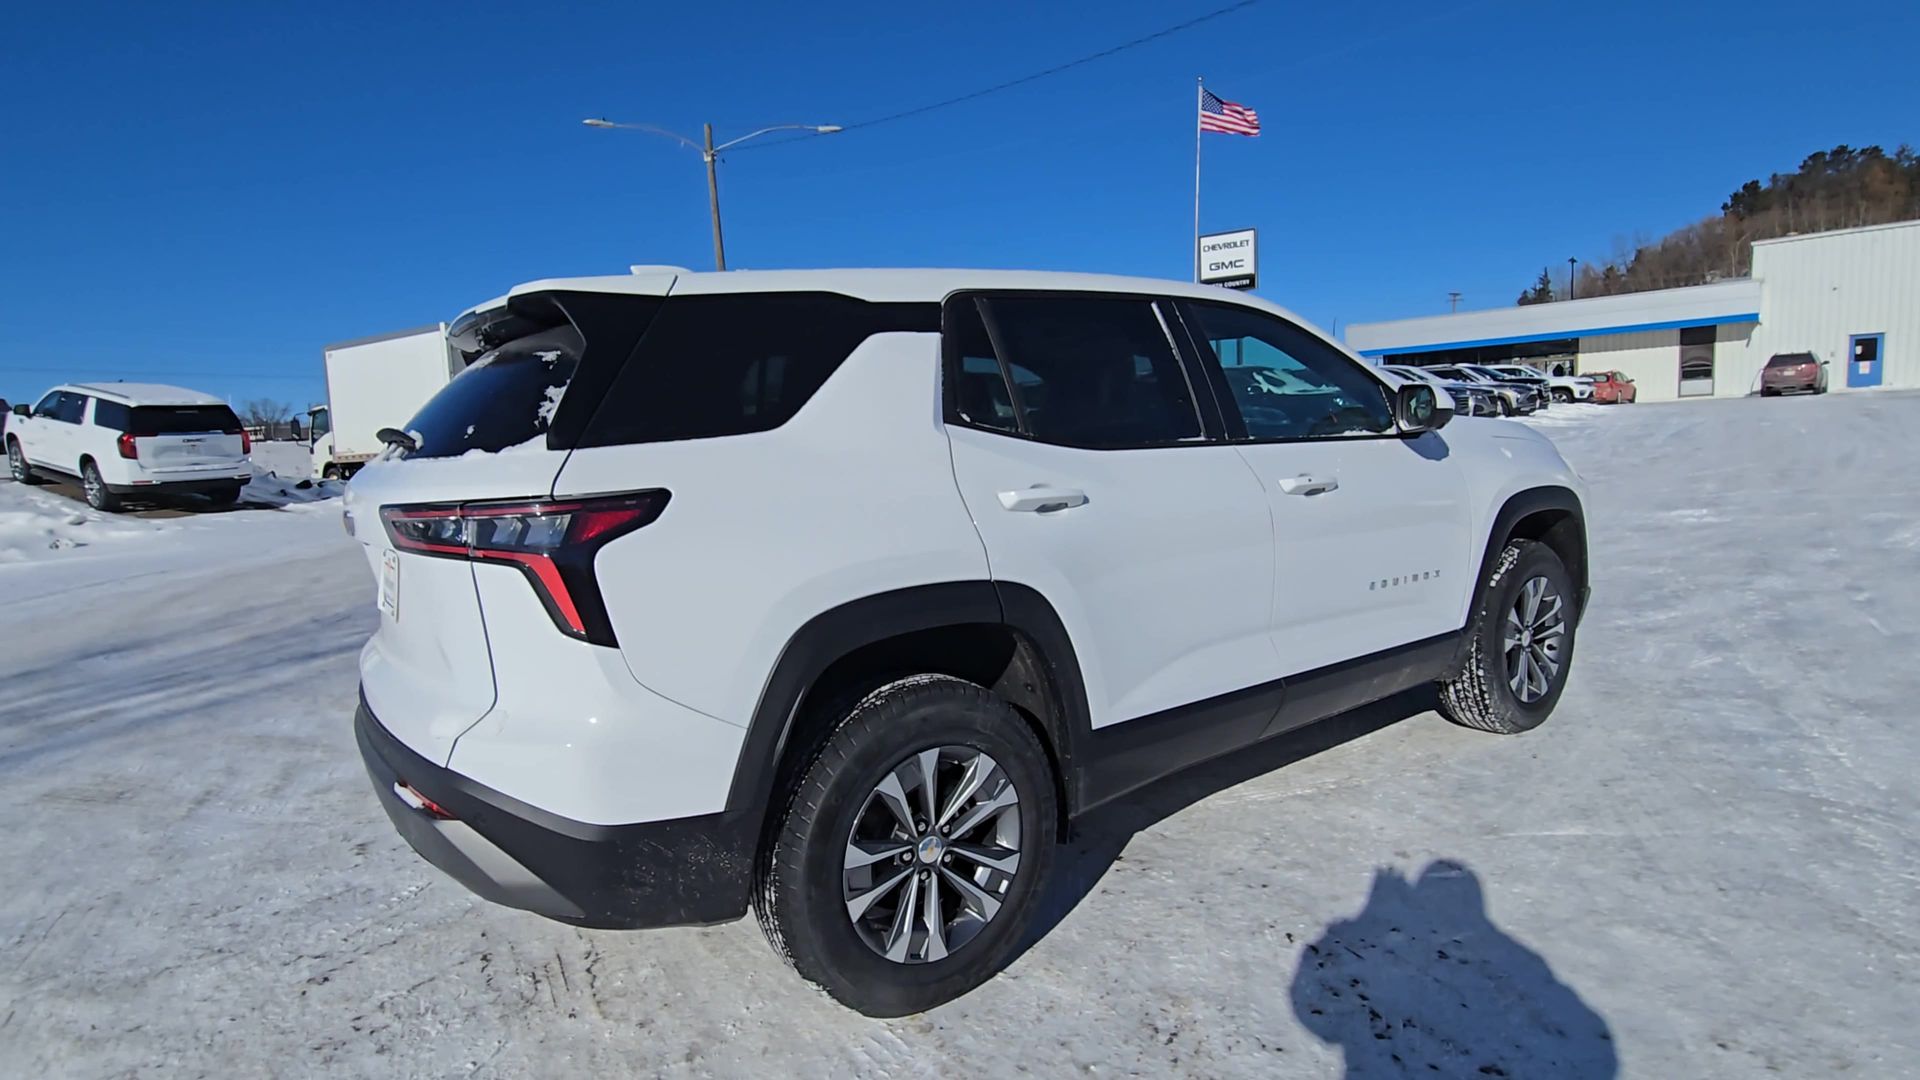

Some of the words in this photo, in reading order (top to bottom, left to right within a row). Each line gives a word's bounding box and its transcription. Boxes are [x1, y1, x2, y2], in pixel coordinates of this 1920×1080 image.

[1203, 239, 1250, 253] CHEVROLET
[1209, 259, 1245, 271] GMC
[1223, 279, 1250, 288] COUNTRY
[1369, 569, 1441, 591] EQUINOX
